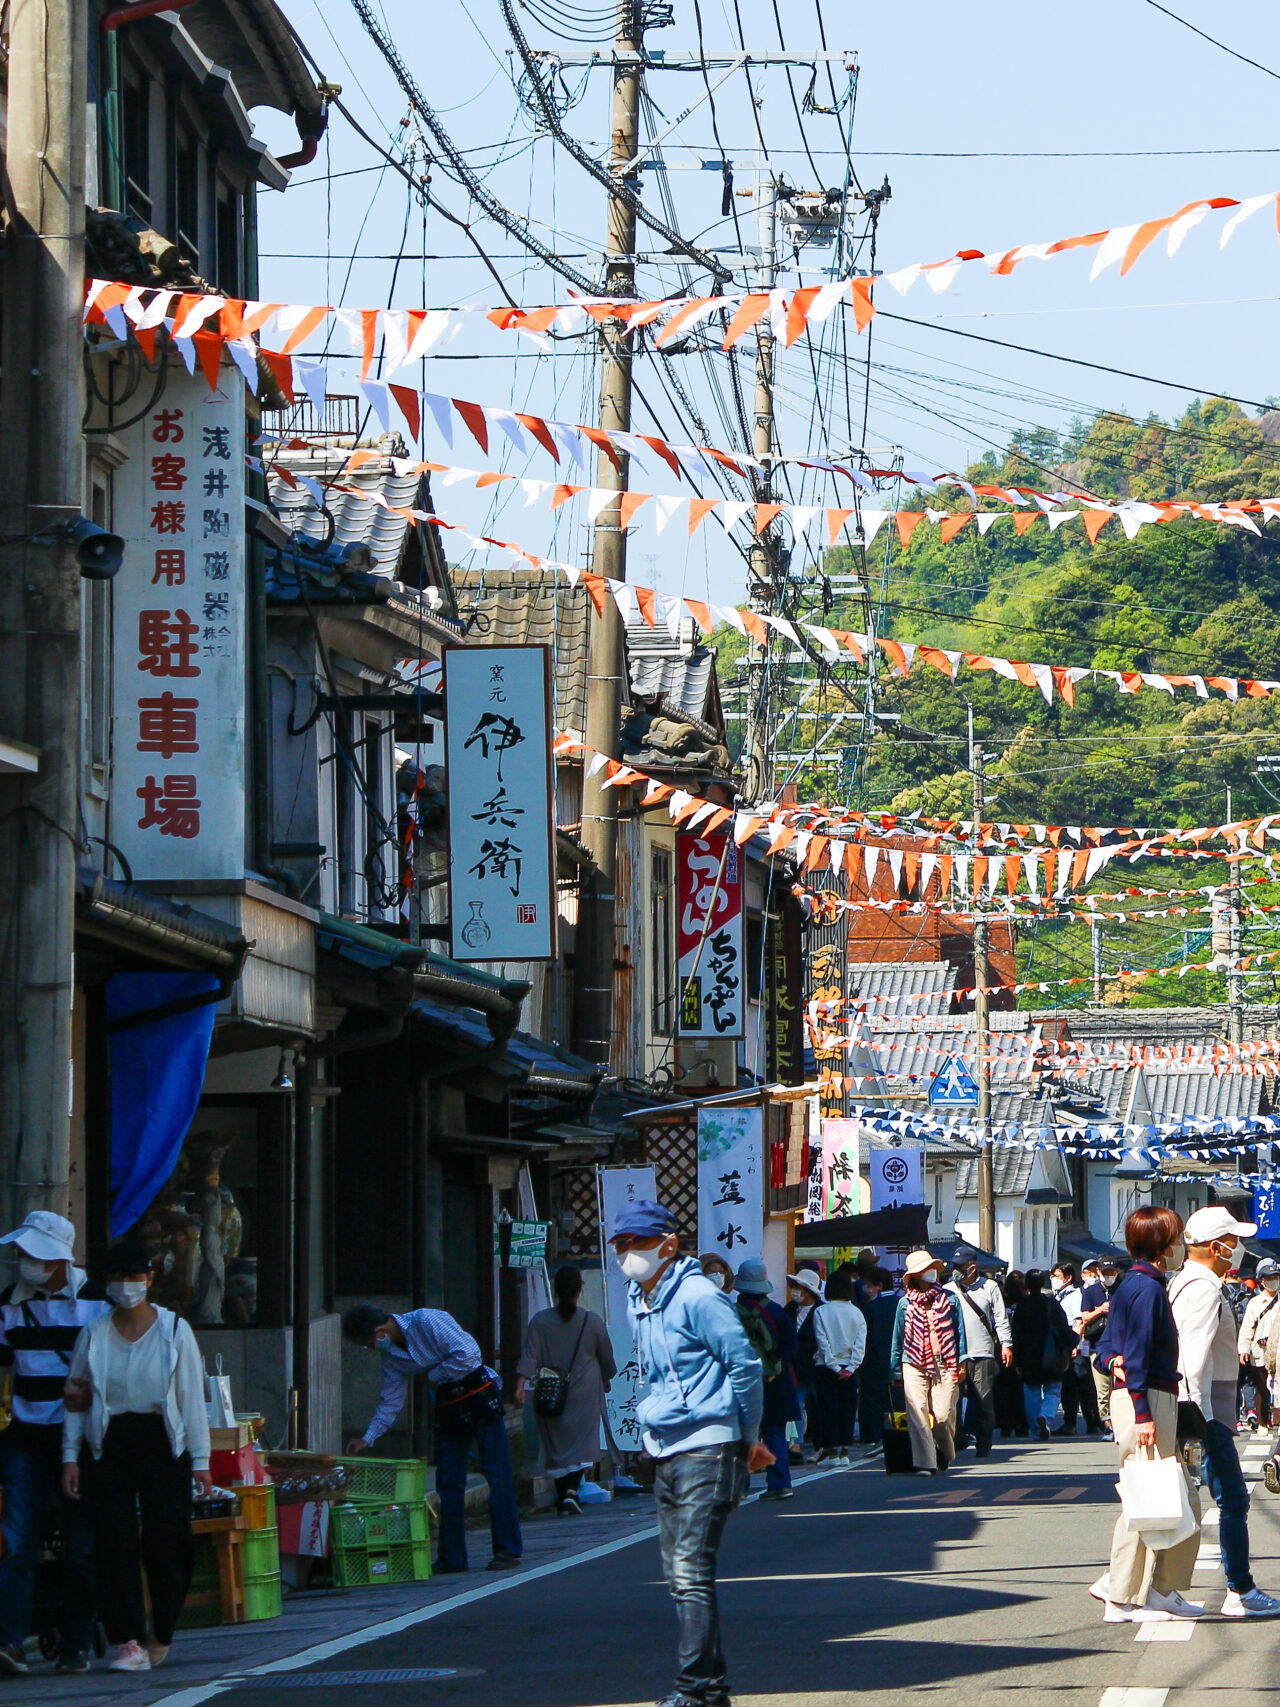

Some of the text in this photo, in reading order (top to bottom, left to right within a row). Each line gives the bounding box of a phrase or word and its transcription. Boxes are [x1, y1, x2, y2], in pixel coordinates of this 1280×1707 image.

[136, 408, 202, 839] お客様用駐車場
[488, 664, 507, 703] 窯元
[463, 711, 526, 898] 伊兵衛
[681, 838, 729, 936] らーめん
[703, 930, 739, 1033] ちゃんぽん
[712, 1170, 748, 1250] 藍水
[808, 1167, 823, 1222] 村岡総
